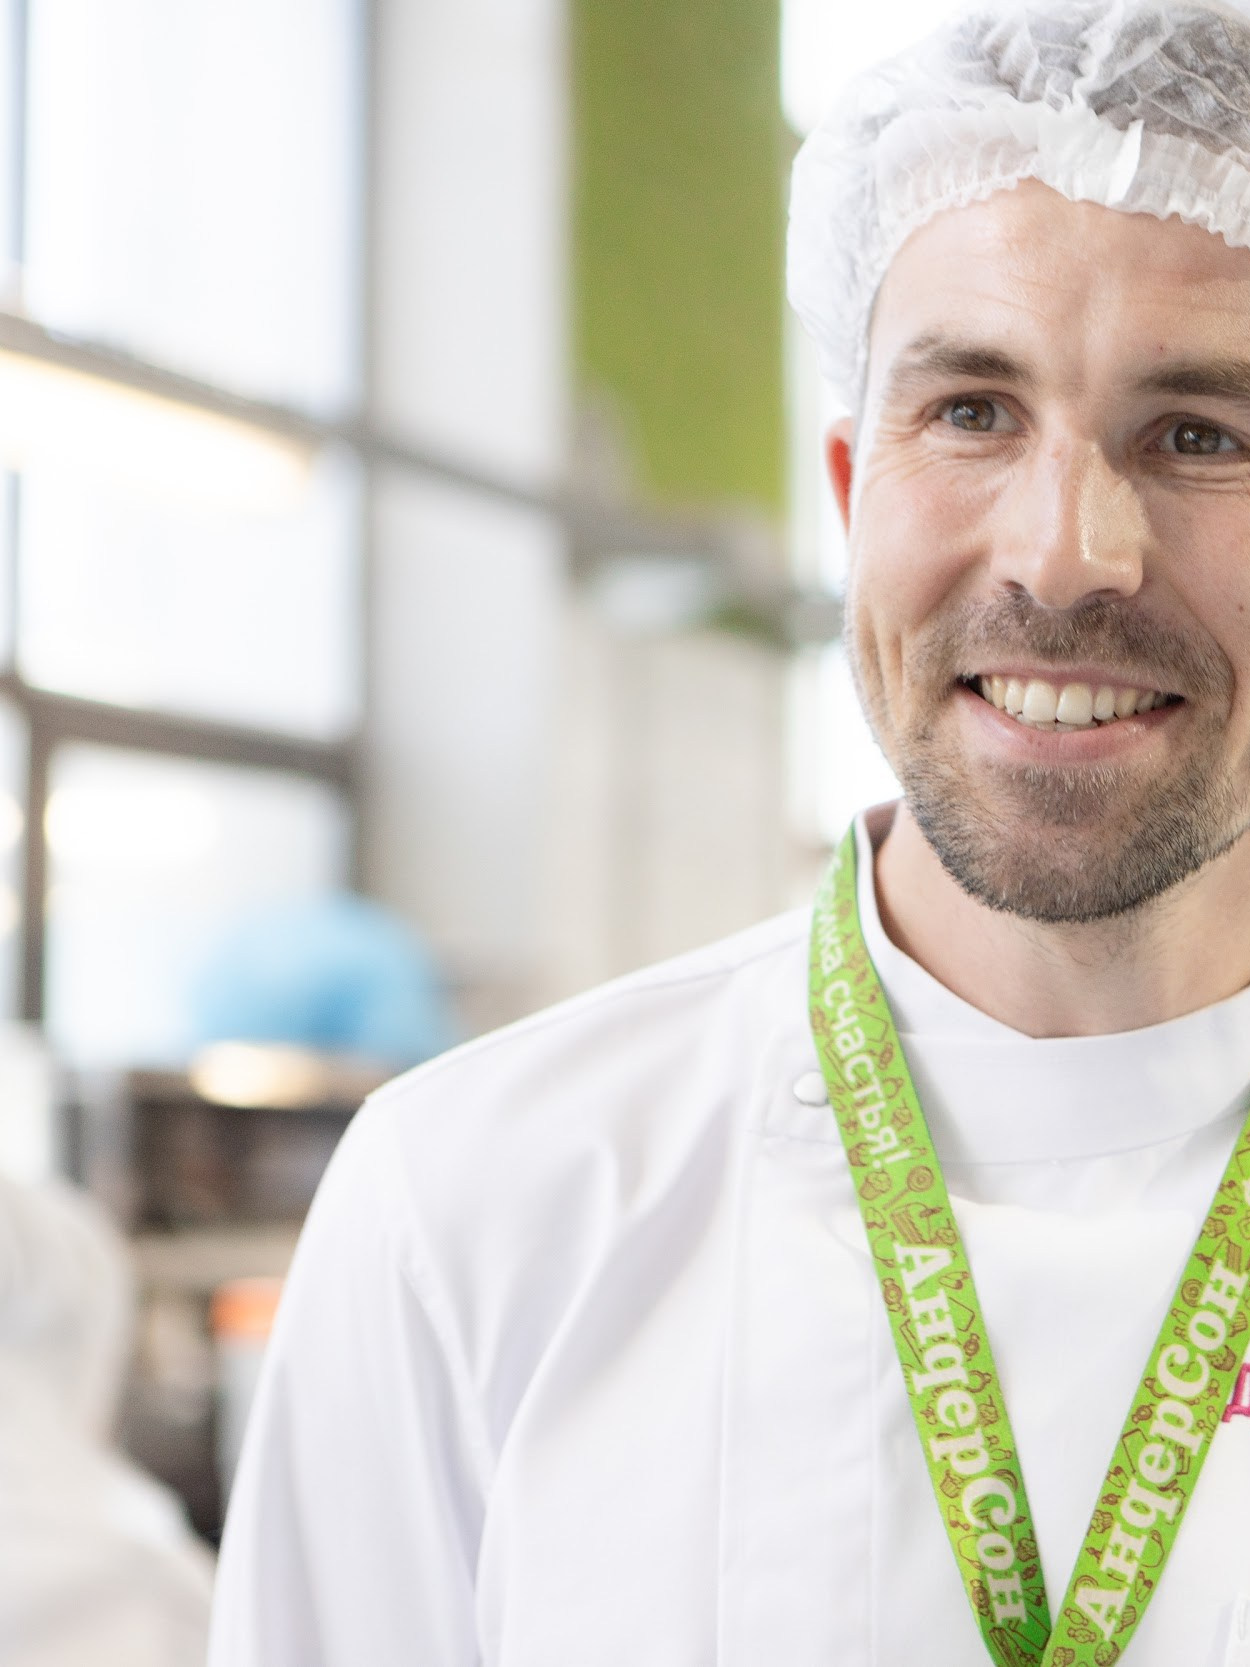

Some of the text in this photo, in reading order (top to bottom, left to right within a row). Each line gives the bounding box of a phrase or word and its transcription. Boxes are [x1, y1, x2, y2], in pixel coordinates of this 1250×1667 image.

[823, 979, 912, 1170] счастья!
[893, 1242, 1030, 1626] АндерСон
[1074, 1259, 1250, 1642] АндерСон
